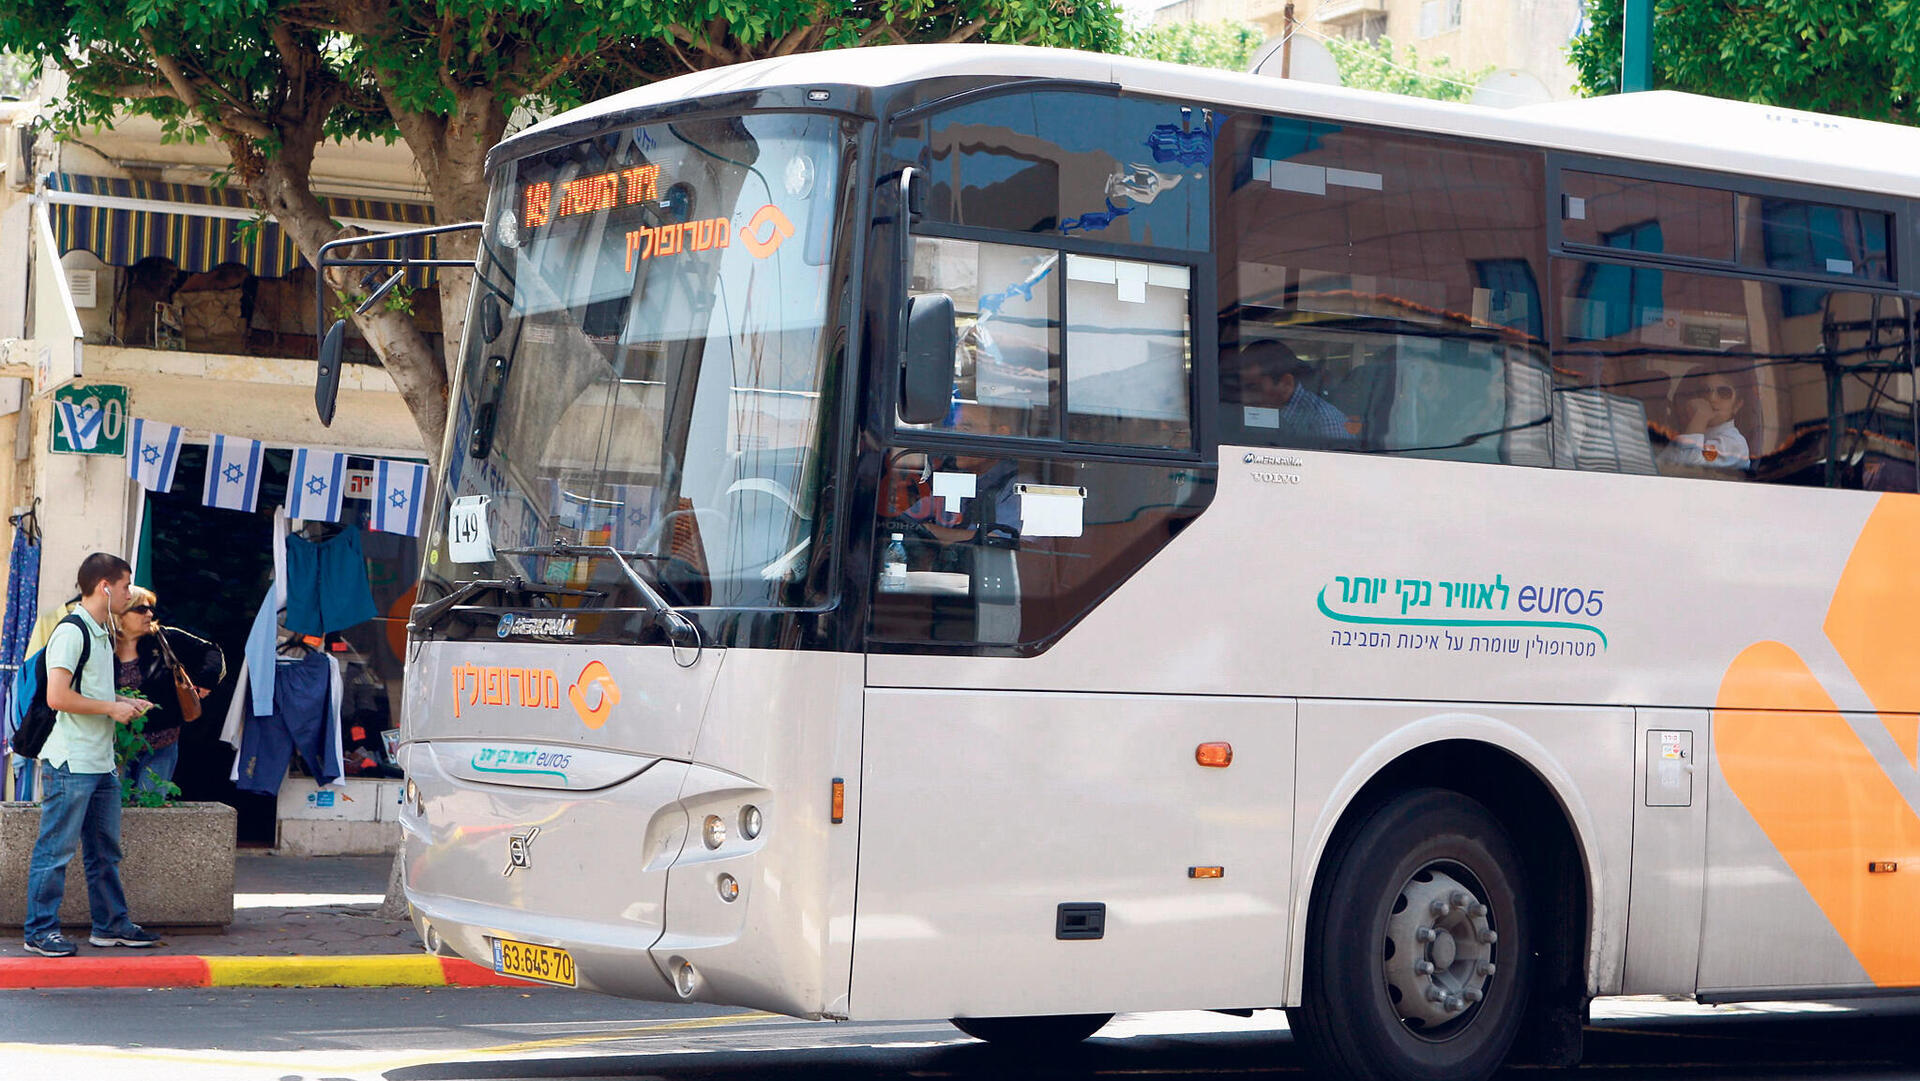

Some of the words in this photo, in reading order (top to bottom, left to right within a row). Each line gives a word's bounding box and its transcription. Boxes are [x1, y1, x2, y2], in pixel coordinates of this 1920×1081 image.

[524, 181, 550, 229] 149
[625, 217, 731, 273] מטרופולין
[1251, 472, 1300, 485] VOLVO
[454, 512, 479, 544] 149
[1335, 576, 1387, 604] יותר
[1395, 579, 1432, 615] נקי
[1438, 573, 1510, 610] לאוויר
[1518, 585, 1604, 617] euro5
[1331, 630, 1391, 649] הסביבה
[1396, 633, 1439, 649] איכות
[1444, 630, 1464, 651] על
[1468, 637, 1520, 654] שומרת
[1525, 634, 1596, 659] מטרופולין
[451, 661, 560, 718] מטרופולין
[536, 751, 572, 769] euro5
